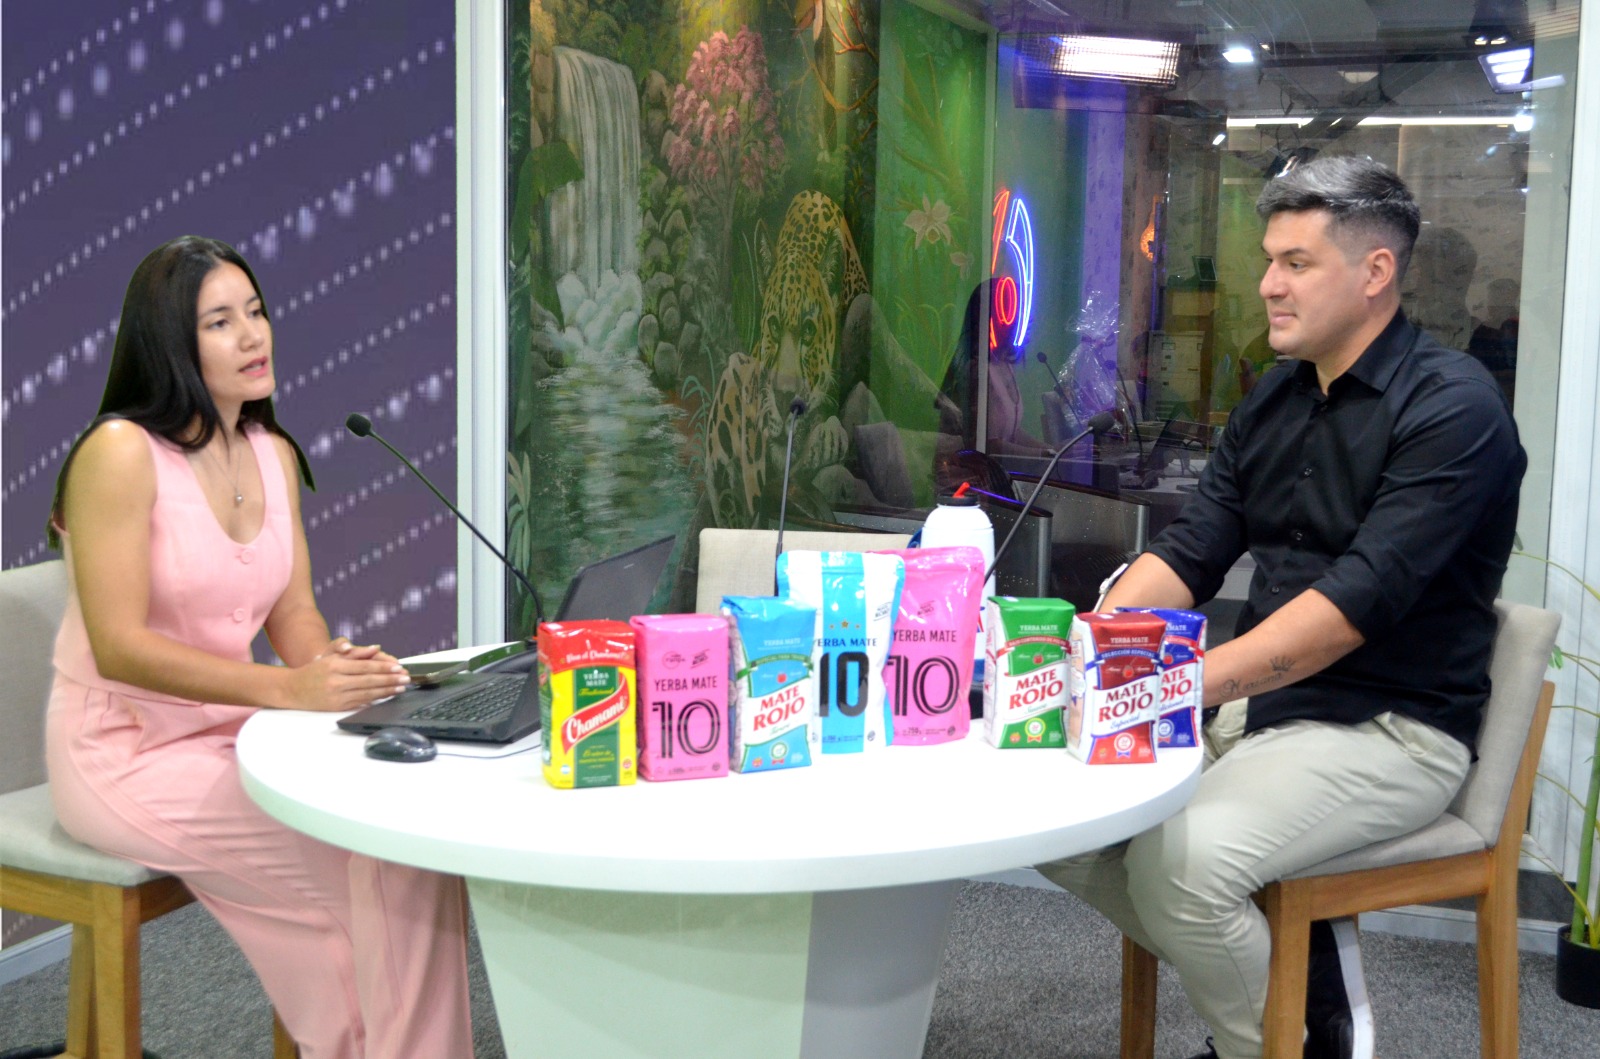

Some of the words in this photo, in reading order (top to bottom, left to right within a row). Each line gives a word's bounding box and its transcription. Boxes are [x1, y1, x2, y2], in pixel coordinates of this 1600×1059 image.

[850, 637, 877, 647] MATE
[893, 629, 926, 642] YERBA
[930, 629, 957, 643] MATE
[585, 679, 607, 687] MATE
[654, 677, 688, 692] YERBA
[691, 675, 718, 690] MATE
[819, 651, 869, 718] 10
[886, 655, 960, 718] 10
[1016, 669, 1057, 691] MATE
[1161, 668, 1187, 684] ATE
[760, 685, 799, 708] MATE
[1009, 680, 1064, 710] ROJO
[1106, 681, 1146, 704] MATE
[753, 697, 805, 732] ROJO
[1098, 692, 1153, 722] ROJO
[652, 699, 721, 759] 10
